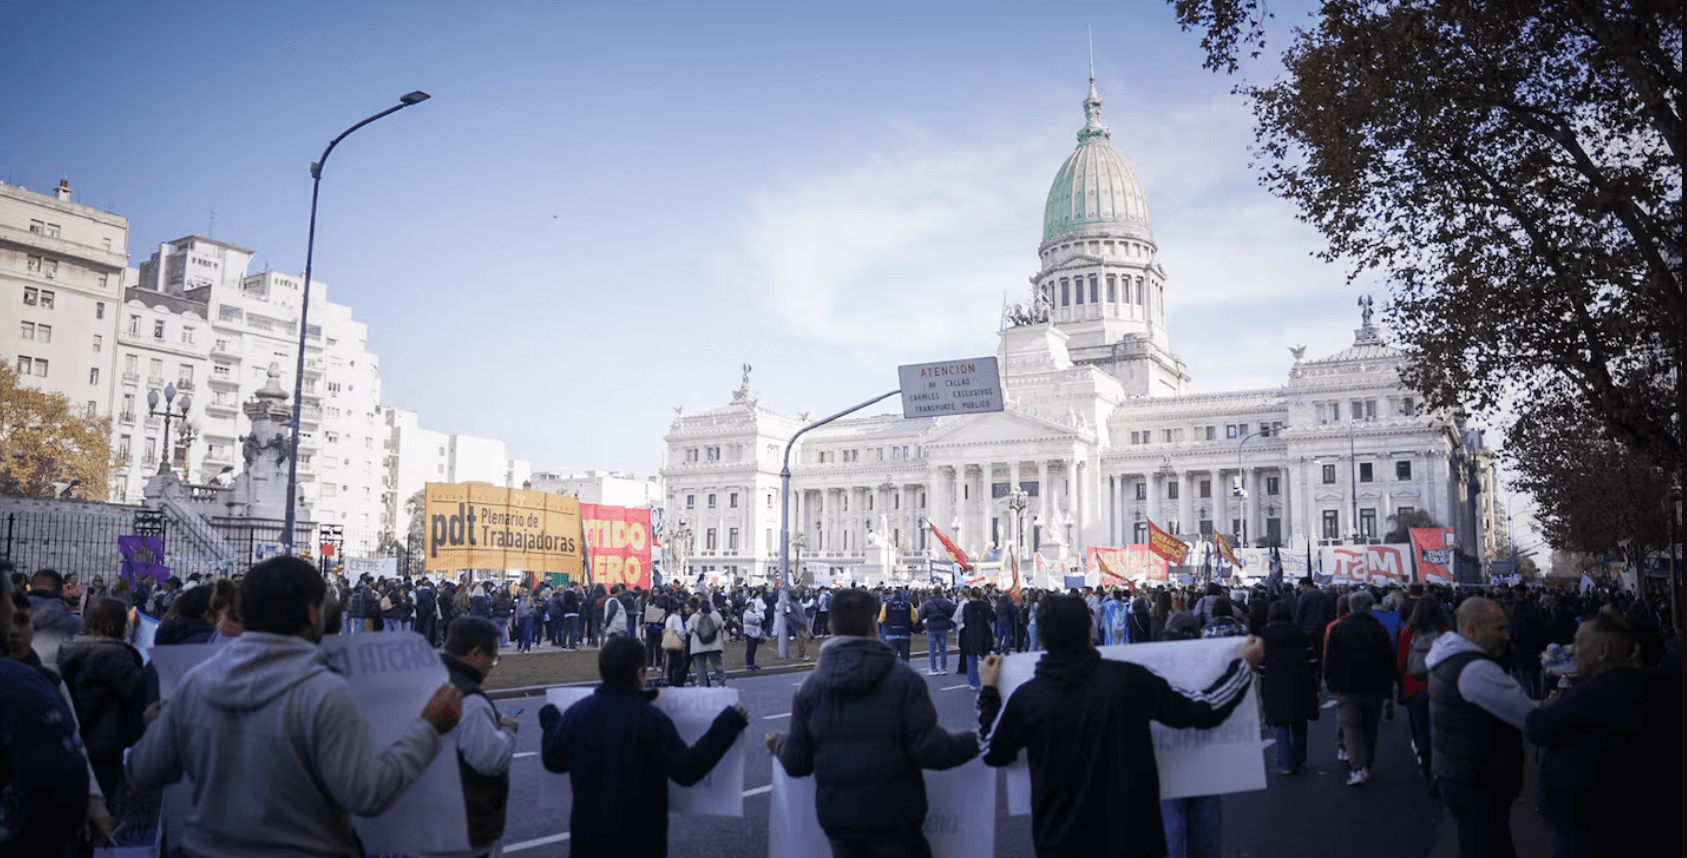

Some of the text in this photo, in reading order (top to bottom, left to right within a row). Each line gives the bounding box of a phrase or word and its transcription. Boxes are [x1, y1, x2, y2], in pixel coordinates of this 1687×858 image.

[920, 363, 975, 378] ATENCION
[945, 378, 970, 387] CALLAO
[909, 387, 993, 402] CARRILES EXCLUSIVOS
[915, 402, 956, 412] TRANSPORTE
[481, 507, 539, 528] Plenario de
[431, 501, 477, 558] pdt
[481, 525, 575, 554] Trabajadoras
